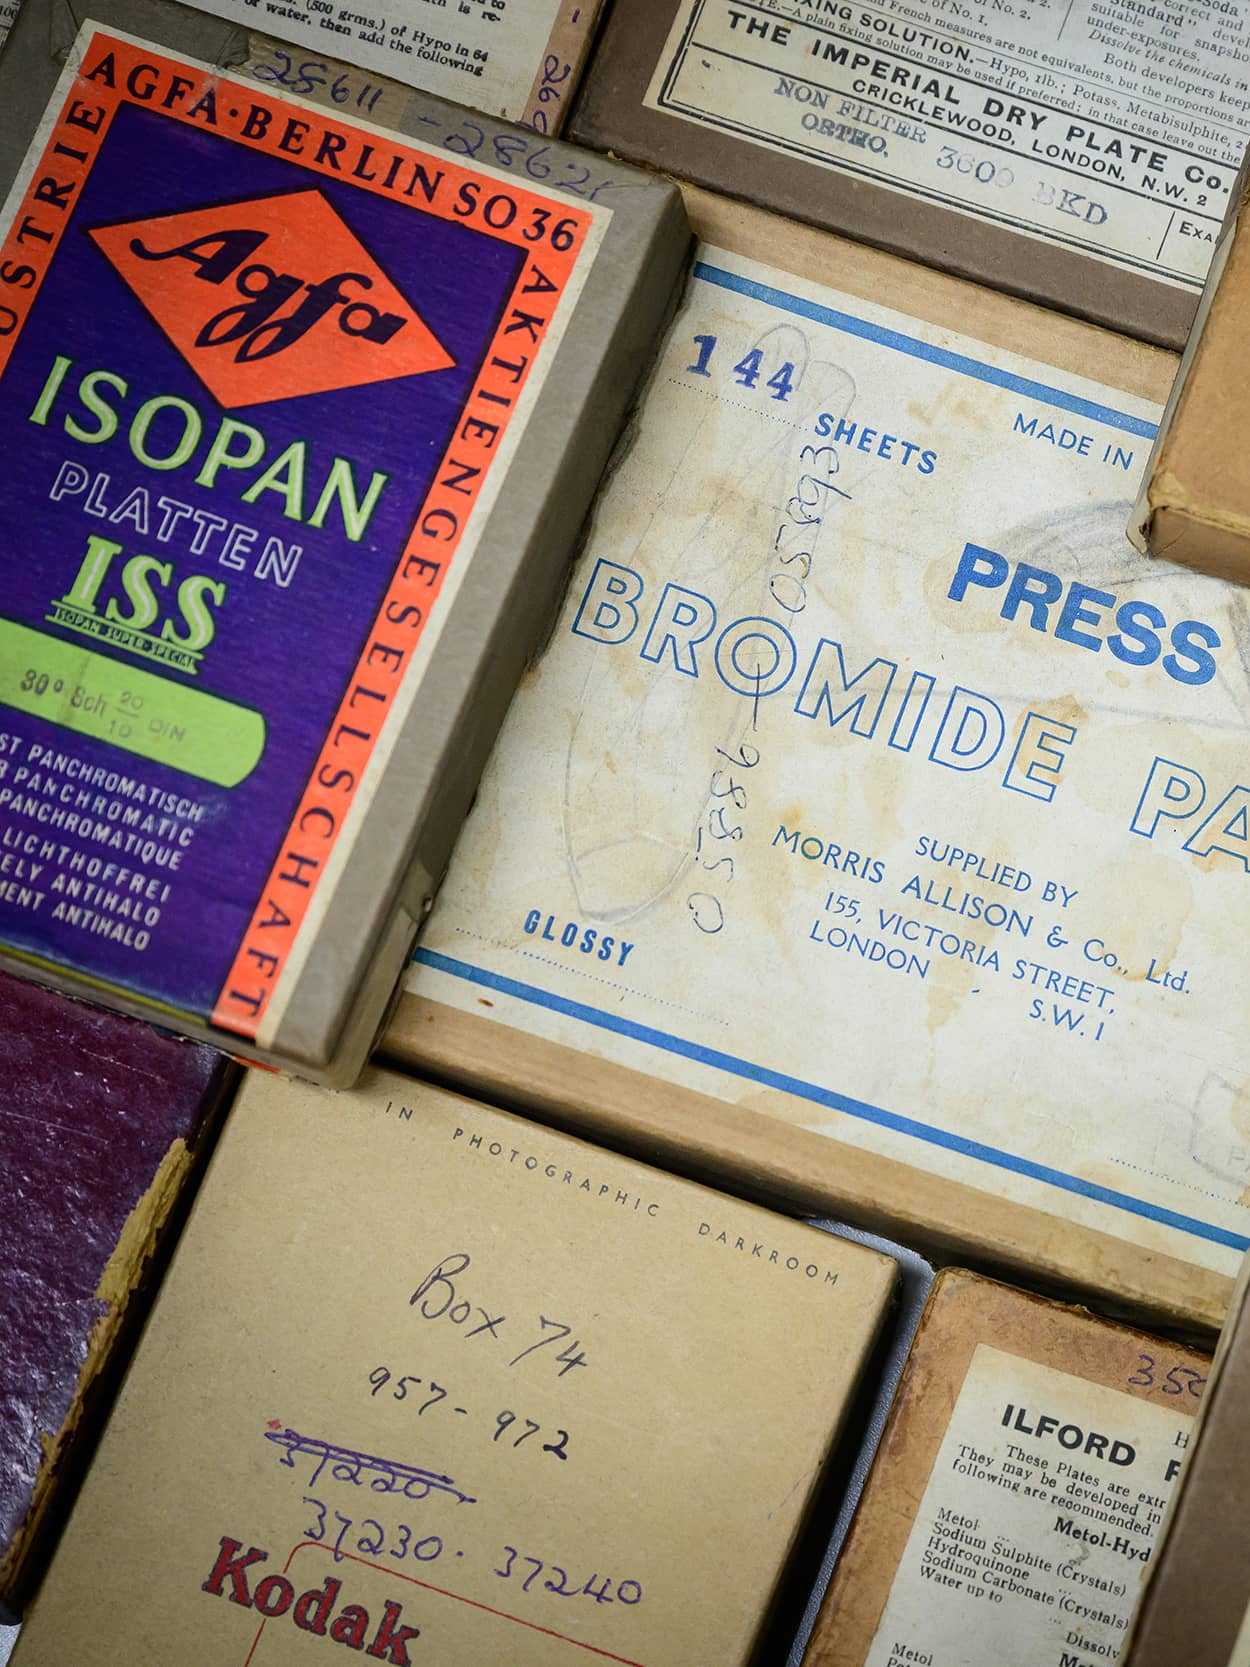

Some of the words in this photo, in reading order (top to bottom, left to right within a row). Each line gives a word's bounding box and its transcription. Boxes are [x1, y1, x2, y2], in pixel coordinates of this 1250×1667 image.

[320, 18, 350, 37] then
[358, 31, 385, 45] add
[390, 40, 412, 53] the
[416, 46, 482, 76] following
[391, 26, 406, 36] of
[412, 31, 451, 51] Hypo
[455, 43, 468, 56] in
[728, 10, 790, 45] THE
[812, 39, 959, 104] IMPERIAL
[982, 97, 1047, 130] DRY
[1066, 125, 1167, 172] PLATE
[1185, 166, 1235, 195] Co.
[774, 77, 828, 108] NON
[836, 100, 927, 143] FILTER
[852, 79, 1014, 145] CRICKLEWOOD,
[1032, 139, 1124, 181] LONDON,
[1196, 195, 1206, 206] 2
[453, 182, 516, 228] SO
[523, 208, 577, 251] 36
[130, 230, 408, 363] Agfa
[28, 353, 386, 541] ISOPAN
[815, 413, 936, 473] SHEETS
[1013, 413, 1093, 455] MADE
[1103, 445, 1132, 469] IN
[49, 461, 302, 587] PLATTEN
[61, 535, 225, 651] ISS
[945, 541, 1229, 688] PRESS
[227, 262, 558, 1017] AKTIENGESELLSCHAFT
[566, 559, 1078, 802] BROMIDE
[14, 768, 193, 846] PANCHROMATIC
[25, 742, 203, 821] PANCHROMATISCH
[3, 828, 169, 901] LICHTHOFFREI
[51, 874, 159, 925] ANTIHALO
[916, 836, 1026, 891] SUPPLIED
[1028, 880, 1078, 907] BY
[49, 898, 153, 952] ANTIHALO
[524, 910, 633, 966] GLOSSY
[772, 826, 884, 883] MORRIS
[901, 875, 1033, 936] ALLISON
[1047, 926, 1068, 947] &
[1141, 959, 1189, 993] Ltd.
[809, 920, 929, 978] LONDON
[825, 892, 860, 923] 155,
[879, 909, 998, 971] VICTORIA
[1012, 960, 1114, 1014] STREET,
[385, 1102, 413, 1120] IN
[453, 1127, 659, 1216] PHOTOGRAPHIC
[698, 1223, 840, 1285] DARKROOM
[410, 1253, 506, 1339] Box
[510, 1316, 587, 1376] 74
[1002, 1405, 1135, 1465] ILFORD
[1007, 1444, 1048, 1469] These
[1056, 1462, 1099, 1486] Plates
[1107, 1483, 1129, 1496] are
[953, 1459, 1020, 1492] following
[1024, 1486, 1046, 1500] are
[959, 1444, 994, 1466] They
[1002, 1463, 1032, 1479] may
[1040, 1472, 1056, 1487] be
[1066, 1482, 1138, 1515] developed
[1147, 1509, 1160, 1523] in
[201, 1536, 421, 1667] Kodak
